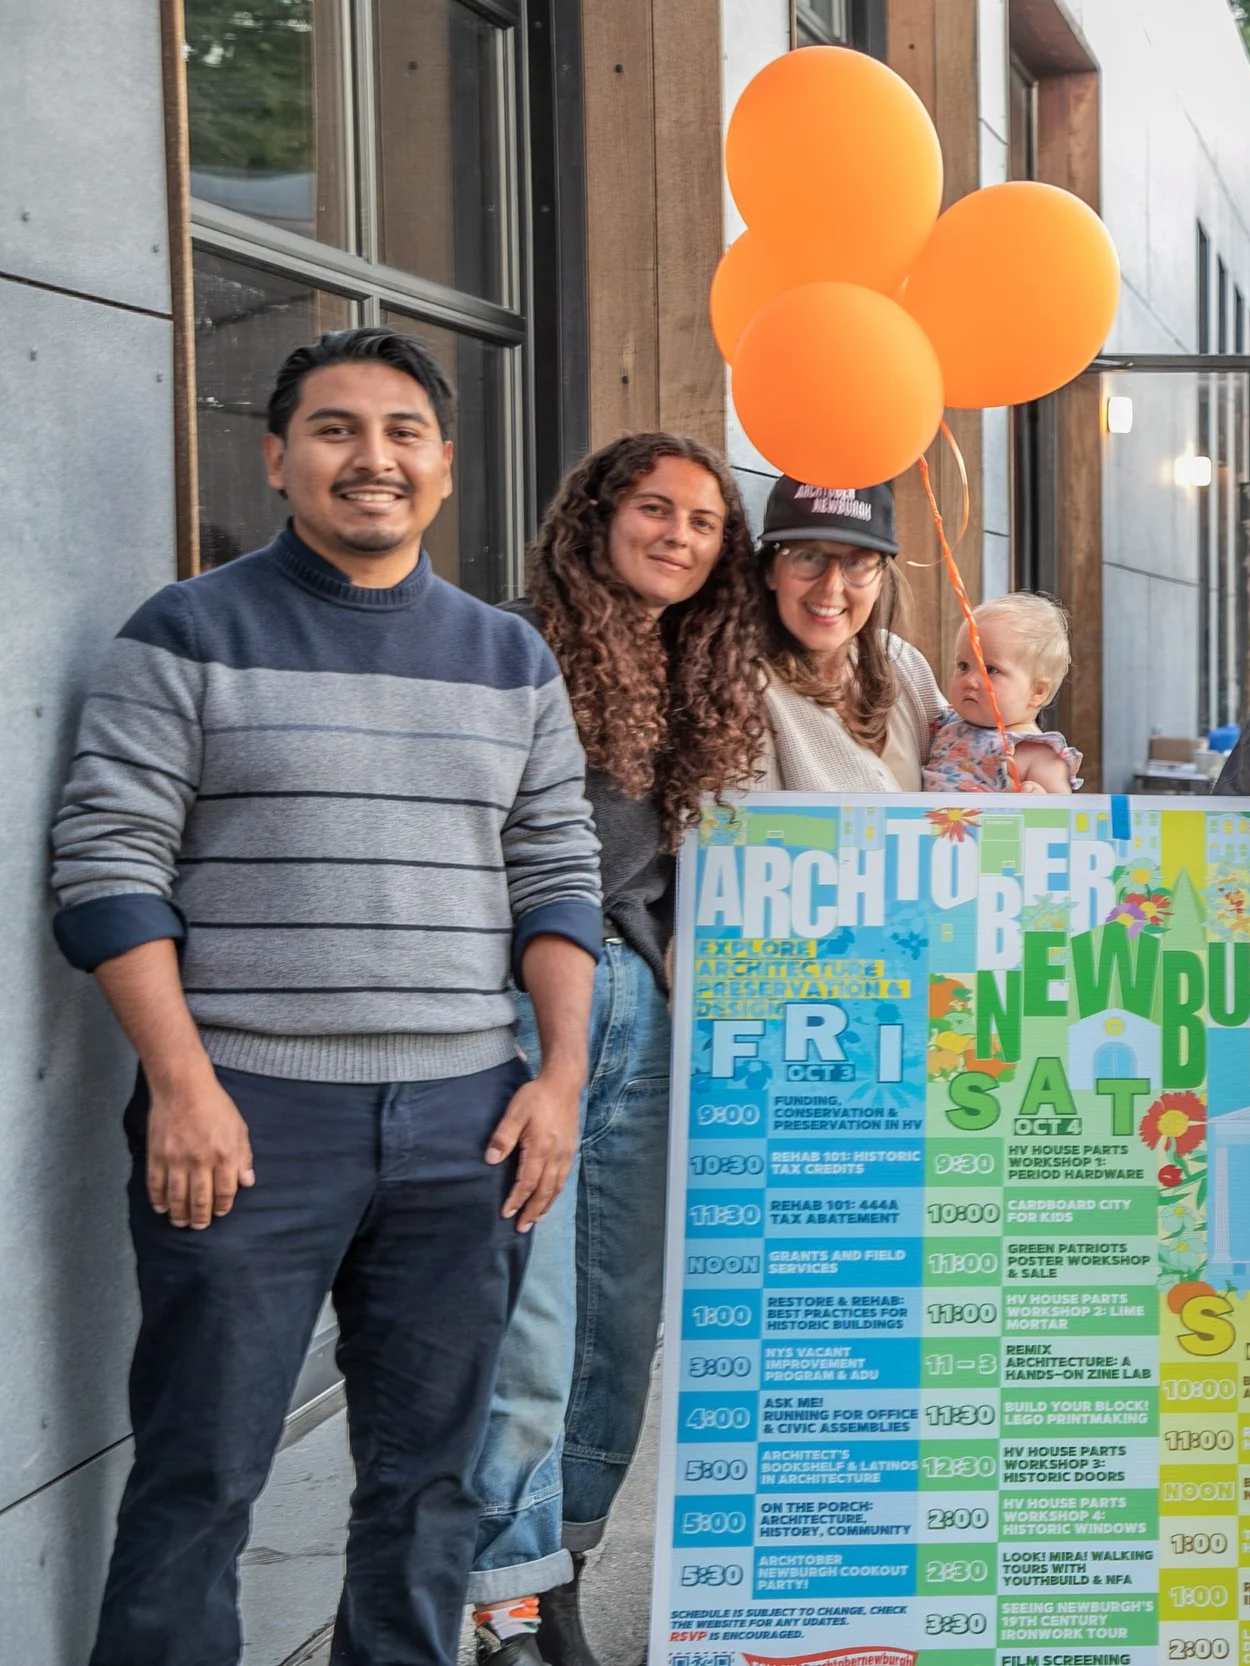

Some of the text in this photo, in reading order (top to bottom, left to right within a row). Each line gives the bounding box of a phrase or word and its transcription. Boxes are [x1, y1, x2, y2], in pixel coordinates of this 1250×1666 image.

[811, 498, 871, 521] NEWBURGH
[696, 819, 1116, 970] ARCHTOBER
[700, 940, 809, 956] EXPLORE
[697, 961, 878, 978] ARCHITECTURE
[696, 981, 879, 998] PRESERVATION
[696, 1002, 784, 1018] DESIGN
[711, 1003, 903, 1083] FRI
[788, 1066, 854, 1081] OCT 3
[774, 1096, 842, 1106] FUNDING,
[946, 1057, 1150, 1136] SAT
[697, 1104, 760, 1125] 9:00
[774, 1108, 884, 1118] CONSERVATION
[774, 1120, 922, 1130] PRESERVATION HV
[1015, 1119, 1081, 1135] OCT 4
[1009, 1145, 1128, 1155] HV HOUSE PARTS
[691, 1155, 764, 1174] 10:30
[935, 1154, 994, 1174] 9:30
[1009, 1157, 1091, 1167] WORKSHOP
[1008, 1169, 1144, 1179] PERIOD HARDWARE
[770, 1200, 898, 1210] REHAB 101: 444A
[1008, 1200, 1131, 1210] CARDBOARD CITY
[689, 1204, 761, 1226] 11:30
[771, 1213, 900, 1224] TAX ABATEMENT
[928, 1204, 999, 1223] 10:00
[1007, 1212, 1073, 1222] FOR KIDS
[1008, 1244, 1127, 1253] GREEN PATRIOTS
[688, 1256, 760, 1274] NOON
[929, 1253, 998, 1274] 11:00
[1008, 1256, 1150, 1266] POSTER WORKSHOP
[1021, 1269, 1057, 1278] SALE
[768, 1296, 904, 1307] RESTORE REHAB:
[1006, 1294, 1128, 1304] HV HOUSE PARTS
[692, 1305, 752, 1326] 1:00
[768, 1308, 908, 1319] BEST PRACTICES FOR
[928, 1303, 997, 1323] 11:00
[1006, 1306, 1145, 1317] WORKSHOP LIME
[767, 1320, 904, 1330] HISTORIC BUILDINGS
[1006, 1319, 1068, 1329] MORTAR
[1007, 1345, 1051, 1354] REMIX
[690, 1356, 751, 1377] 3:00
[1006, 1357, 1118, 1367] ARCHITECTURE:
[1088, 1369, 1151, 1379] ZINE LAB
[1163, 1379, 1236, 1401] 10:00
[764, 1398, 823, 1408] ASK ME!
[1005, 1400, 1149, 1412] BUILD YOUR BLOCK!
[686, 1407, 749, 1429] 4:00
[764, 1409, 919, 1421] RUNNING FOR OFFICE
[926, 1405, 995, 1426] 11:30
[1005, 1414, 1148, 1425] LEGO PRINTMAKING
[778, 1422, 910, 1433] CIVIC ASSEMBLIES
[1165, 1430, 1234, 1450] 11:00
[762, 1450, 850, 1461] ARCHITECT'S
[1004, 1446, 1126, 1457] HV HOUSE PARTS
[685, 1459, 747, 1481] 5:00
[761, 1460, 918, 1472] BOOKSHELF LATINOS
[922, 1456, 996, 1478] 12:30
[1005, 1460, 1088, 1470] WORKSHOP
[778, 1473, 881, 1484] ARCHITECTURE
[1004, 1472, 1125, 1482] HISTORIC DOORS
[1163, 1481, 1235, 1502] NOON
[761, 1501, 874, 1513] ON THE PORCH:
[760, 1514, 867, 1525] ARCHITECTURE,
[928, 1508, 988, 1529] 2:00
[1003, 1511, 1089, 1522] WORKSHOP
[682, 1512, 746, 1535] 5:00
[1003, 1523, 1147, 1535] HISTORIC WINDOWS
[760, 1525, 911, 1537] HISTORY, COMMUNITY
[1171, 1533, 1228, 1554] 1:00
[759, 1555, 843, 1566] ARCHTOBER
[1003, 1551, 1153, 1562] LOOK! MIRA! WALKING
[758, 1566, 909, 1578] NEWBURGH COOKOUT
[926, 1560, 988, 1582] 2:30
[1003, 1564, 1086, 1574] TOURS WITH
[680, 1565, 743, 1587] 5:30
[1003, 1575, 1132, 1586] YOUTHBUILD NFA
[758, 1580, 808, 1590] PARTY!
[1170, 1585, 1228, 1608] 1:00
[670, 1606, 908, 1619] SCHEDULE SUBJECT CHANGE, CHECK
[671, 1617, 849, 1629] THE WEBSITE FOR ANY UDATES.
[925, 1613, 987, 1635] 3:30
[669, 1630, 805, 1641] RSVP ENCOURAGED.
[1169, 1638, 1229, 1660] 2:00
[1003, 1654, 1131, 1666] FILM SCREENING
